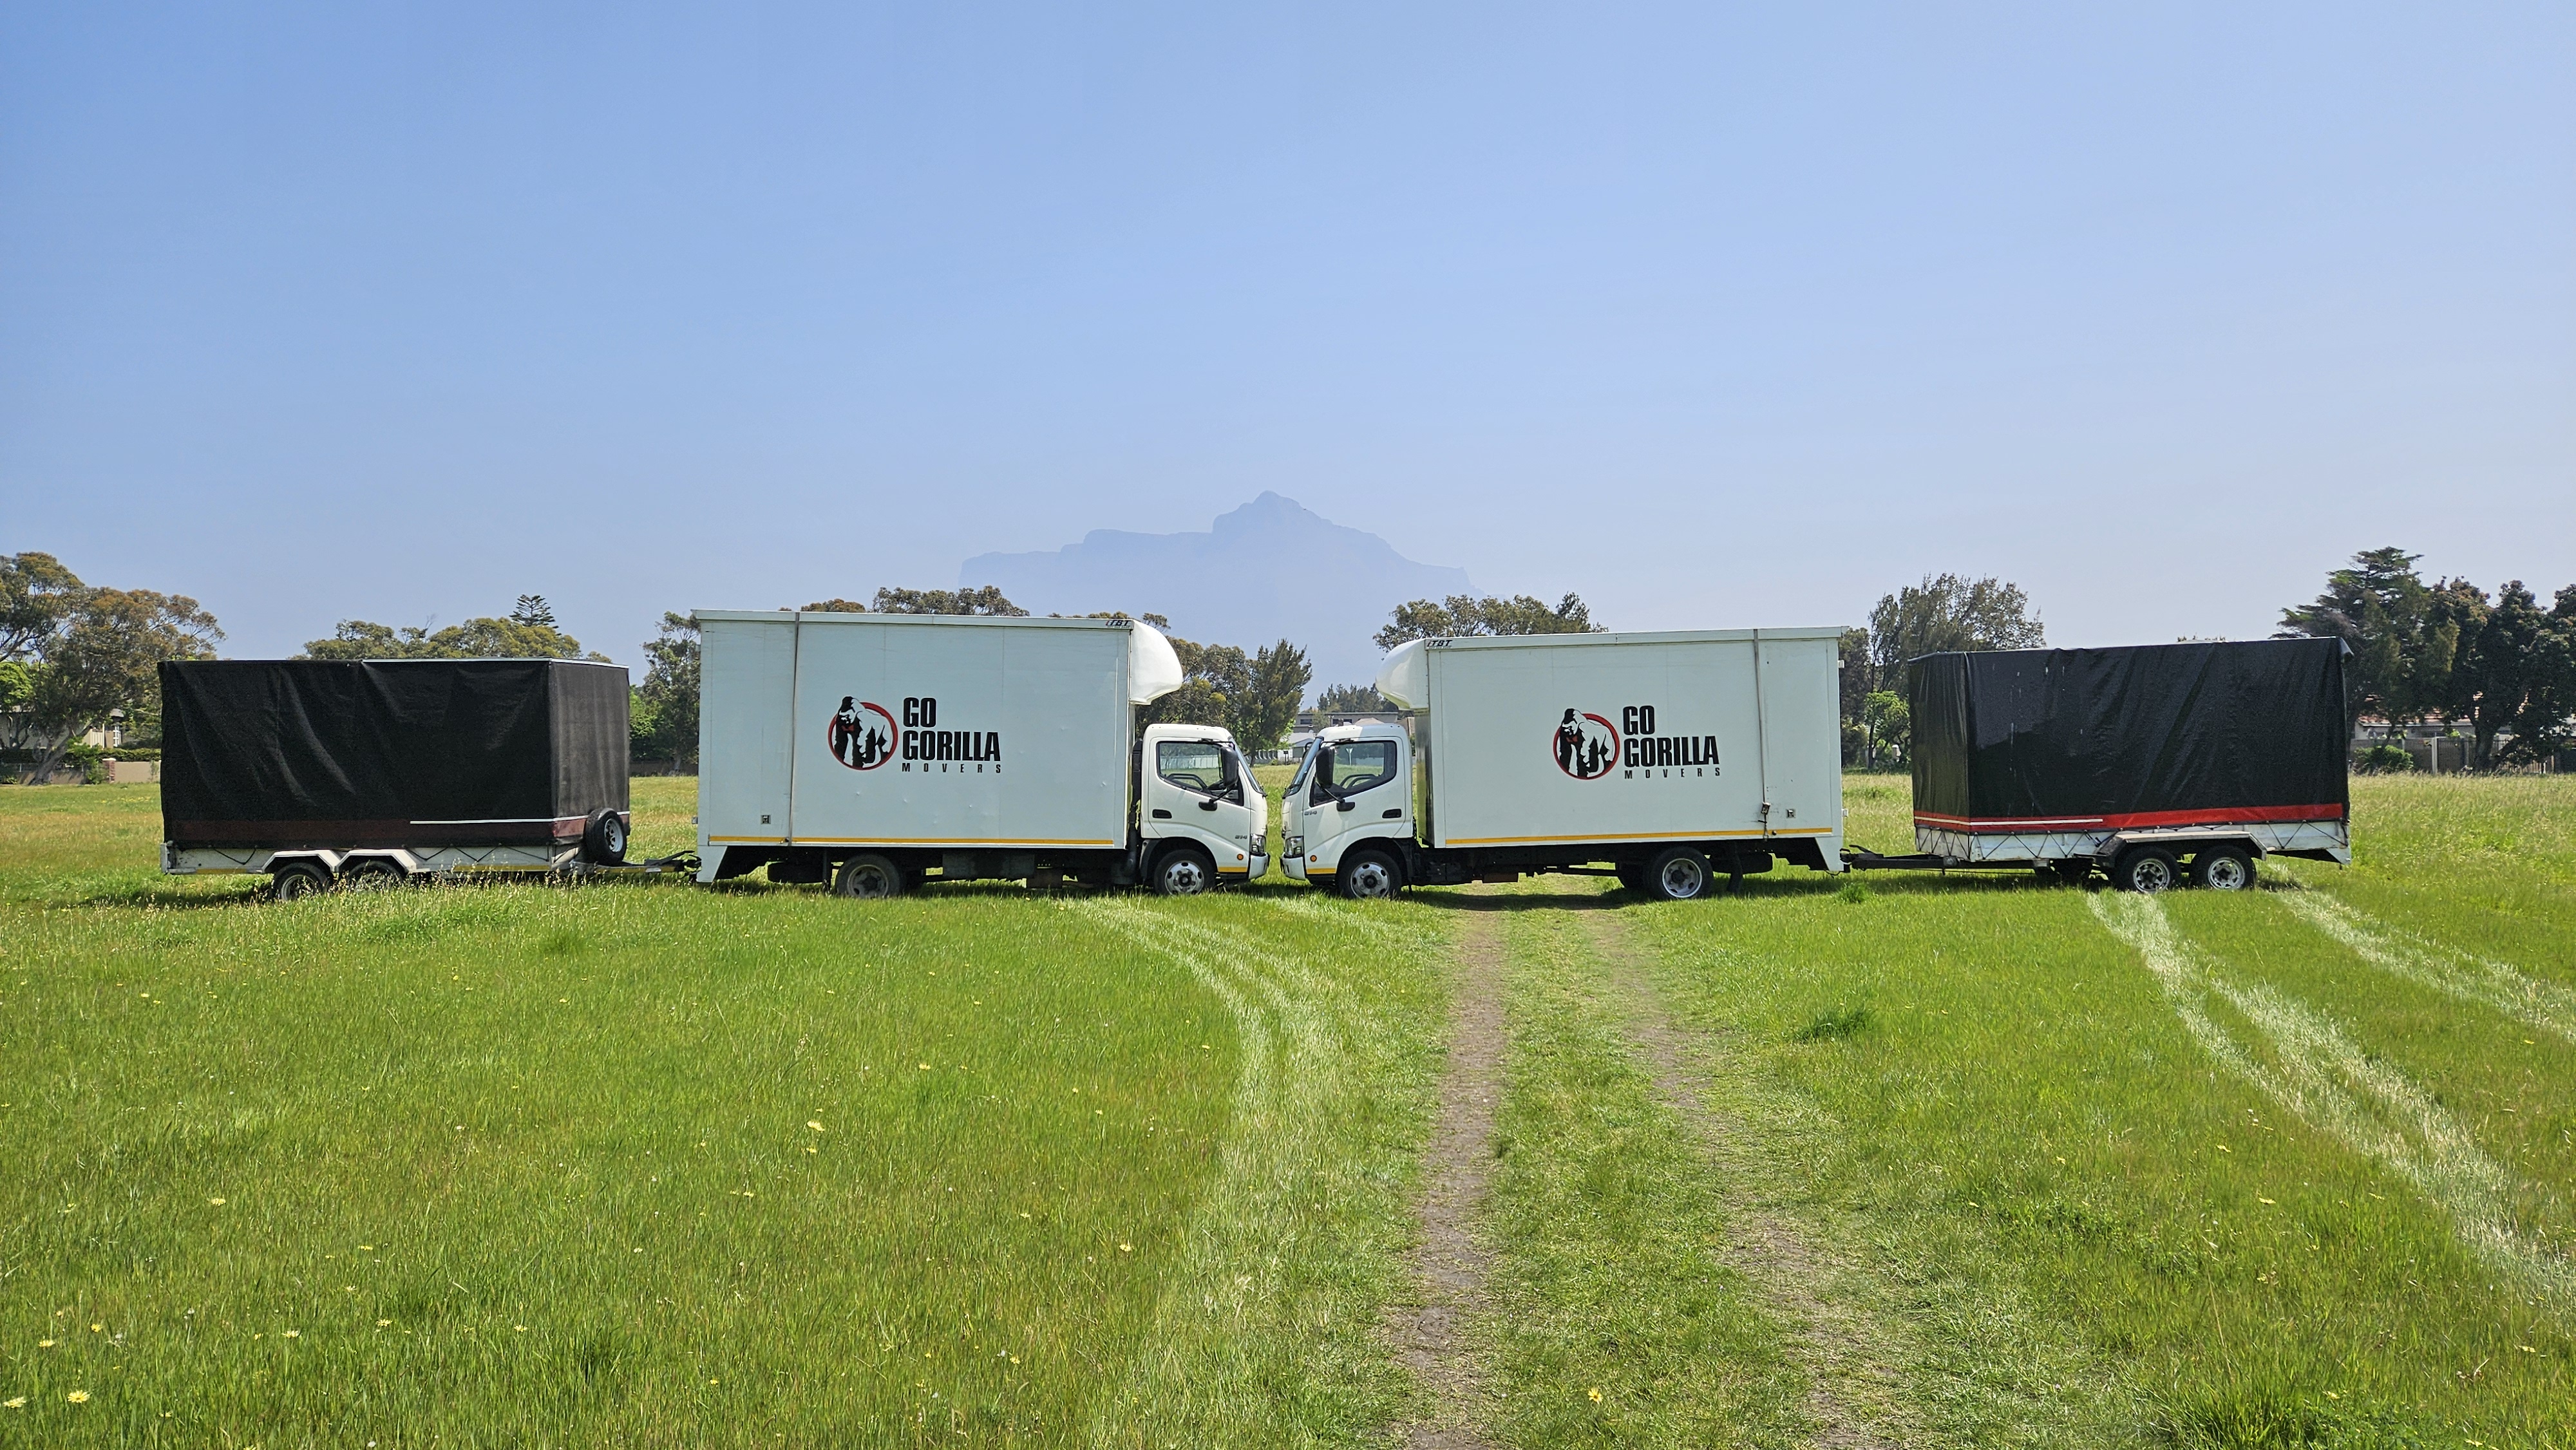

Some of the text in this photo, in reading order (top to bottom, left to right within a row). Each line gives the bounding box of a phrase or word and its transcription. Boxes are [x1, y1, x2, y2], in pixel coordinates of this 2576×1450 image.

[904, 697, 936, 728] GO
[1623, 706, 1655, 735] GO
[903, 730, 1001, 761] GORILLA
[1624, 736, 1719, 767] GORILLA
[902, 763, 1001, 773] MOVERS
[1625, 767, 1720, 779] MOVERS
